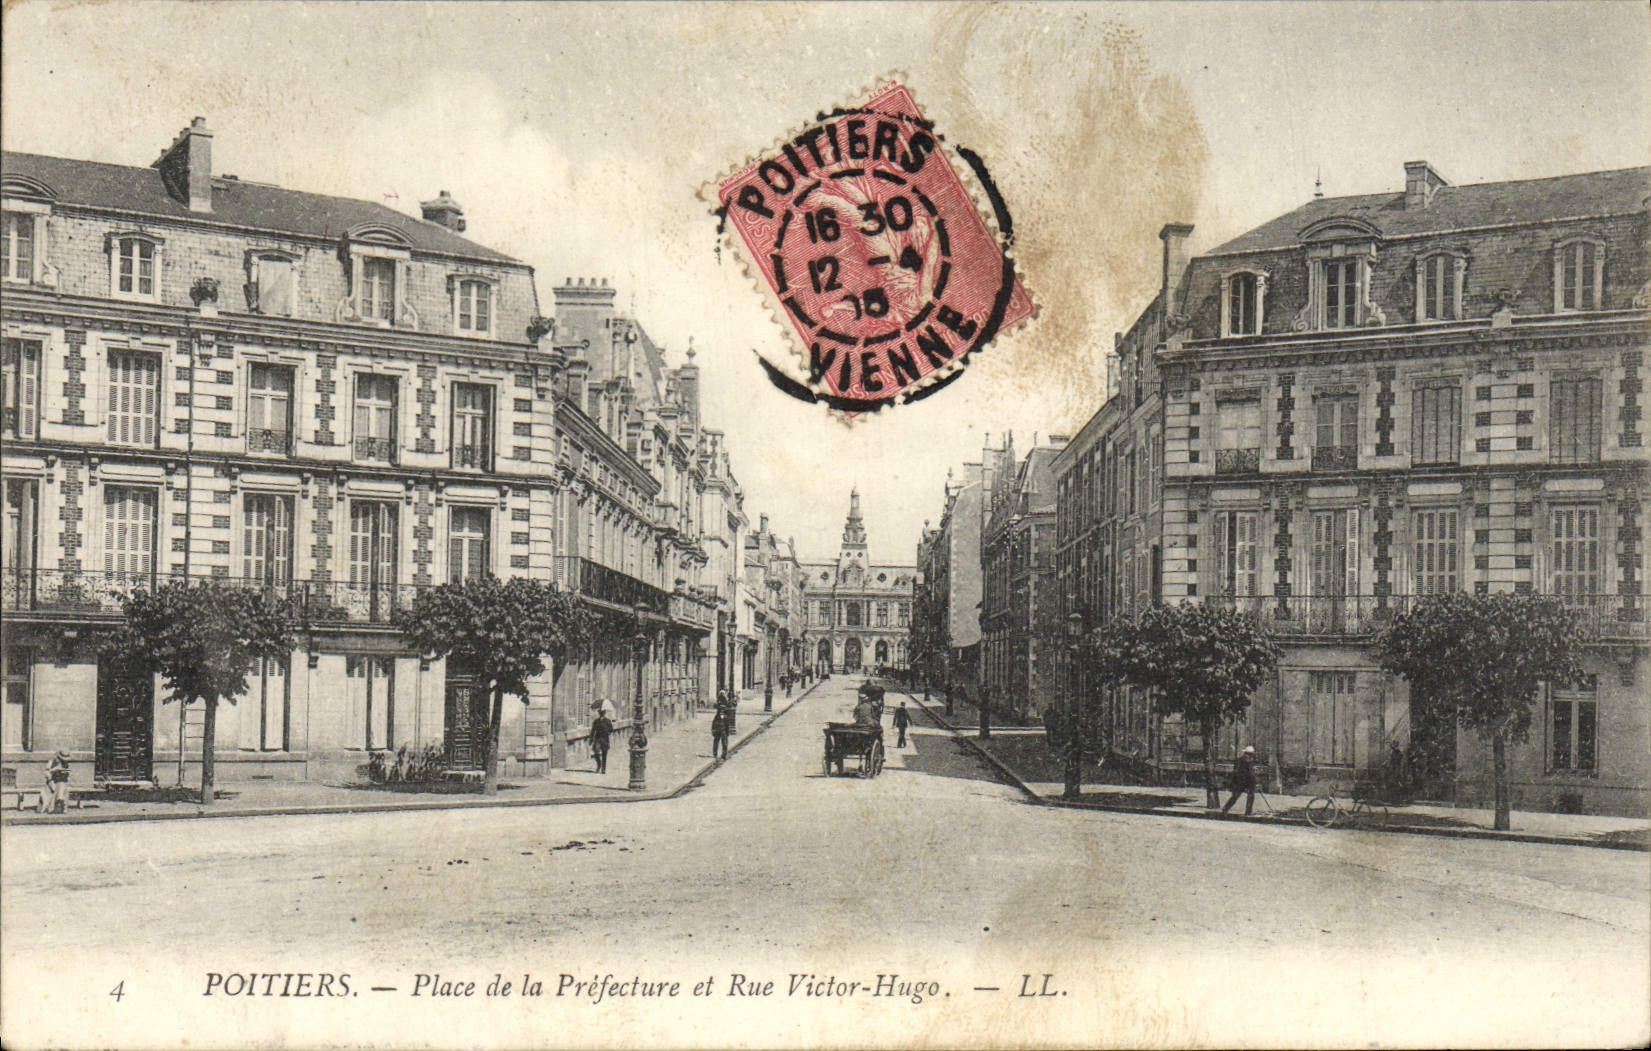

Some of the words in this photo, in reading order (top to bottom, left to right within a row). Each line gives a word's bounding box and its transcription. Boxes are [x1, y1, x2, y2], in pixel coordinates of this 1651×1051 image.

[738, 120, 934, 218] POITIERS
[805, 207, 841, 244] 16
[857, 196, 913, 236] 30
[808, 256, 843, 294] 12
[811, 306, 977, 391] VIENNE
